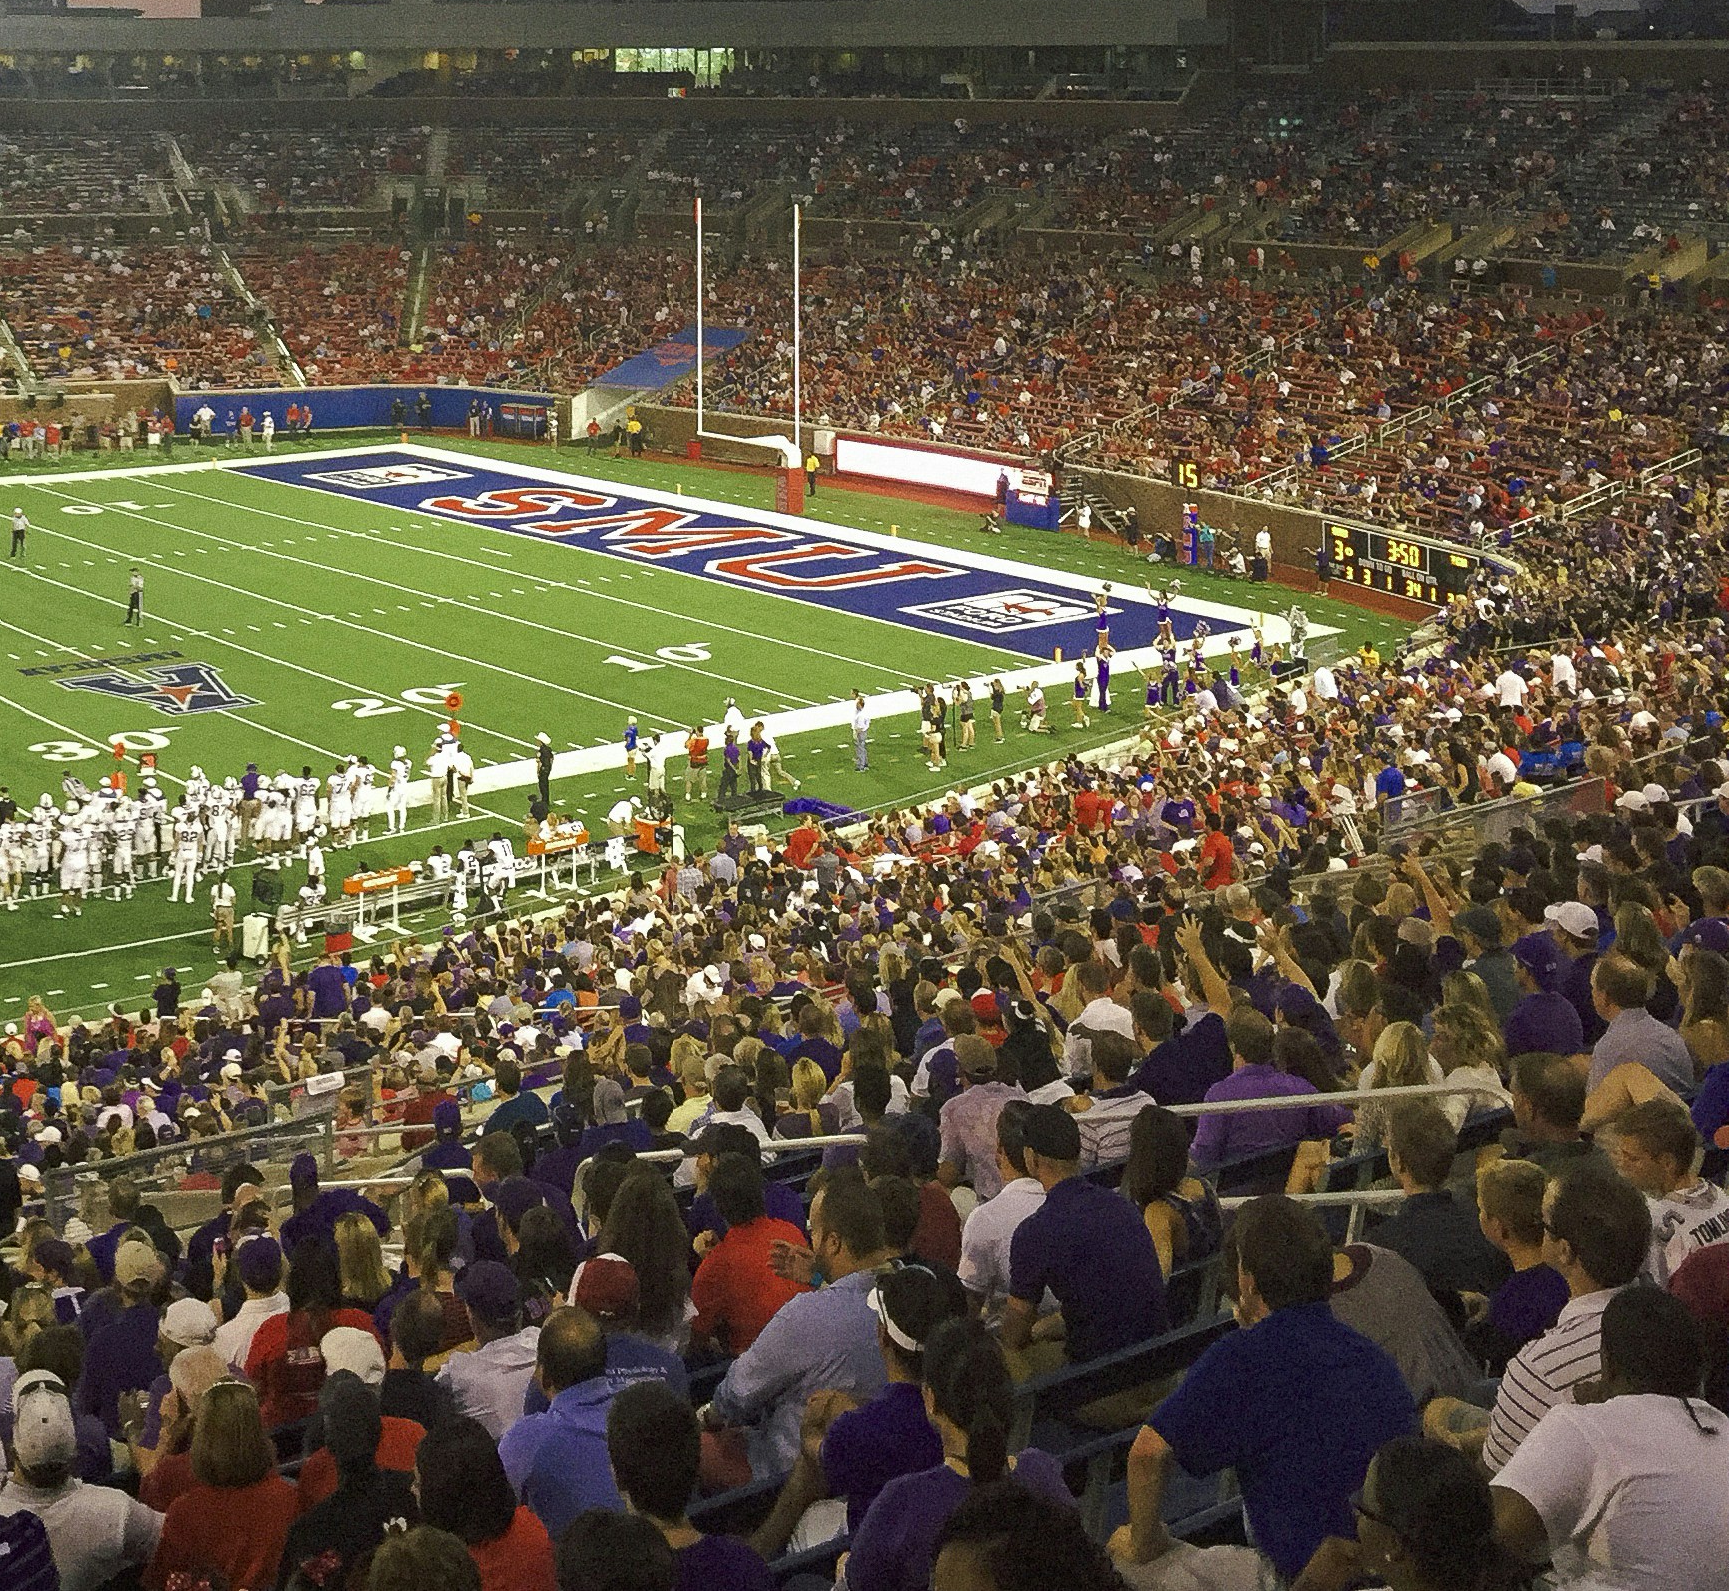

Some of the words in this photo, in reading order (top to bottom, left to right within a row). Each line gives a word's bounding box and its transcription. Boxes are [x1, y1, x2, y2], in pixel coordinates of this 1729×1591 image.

[1022, 475, 1046, 487] ESPN
[1179, 463, 1198, 489] 15
[60, 501, 155, 515] 10
[418, 486, 970, 592] SMU
[1335, 539, 1344, 561] 3
[1405, 579, 1422, 598] 34
[603, 642, 712, 673] 10
[330, 683, 454, 718] 20
[29, 728, 172, 762] 30
[212, 803, 227, 816] 87
[181, 831, 198, 842] 82
